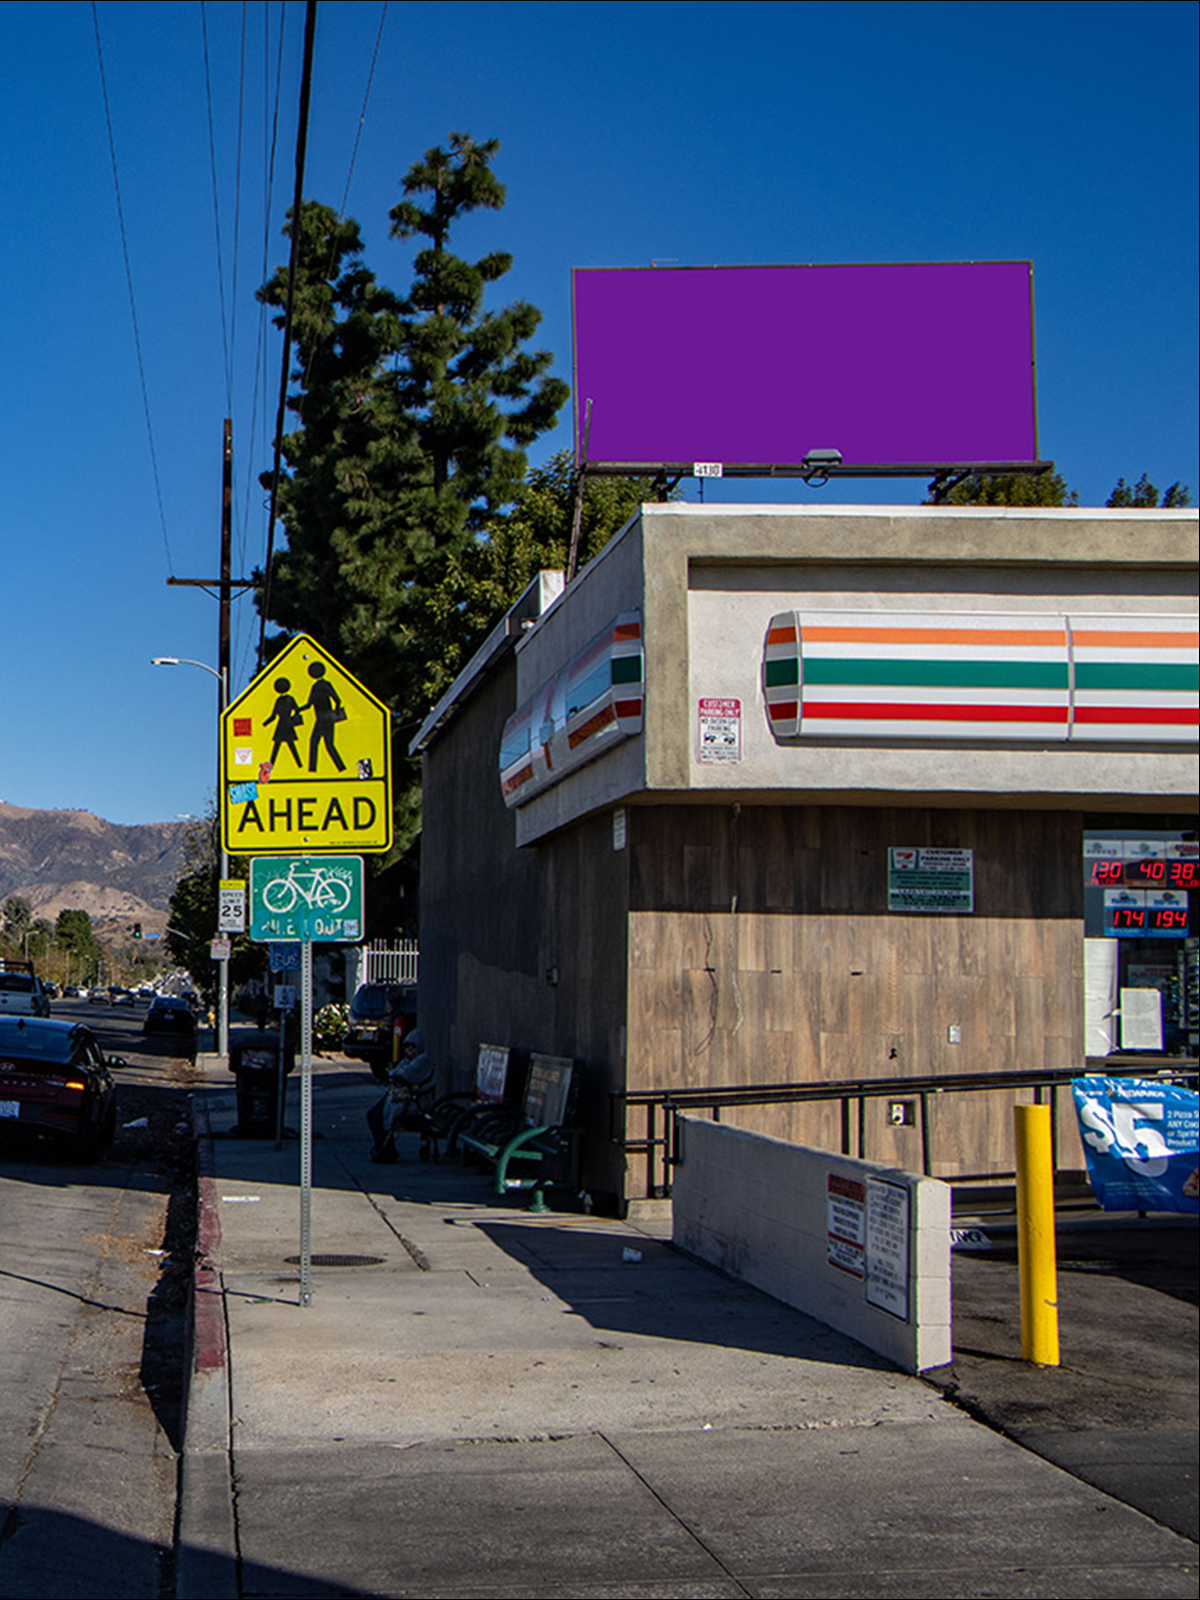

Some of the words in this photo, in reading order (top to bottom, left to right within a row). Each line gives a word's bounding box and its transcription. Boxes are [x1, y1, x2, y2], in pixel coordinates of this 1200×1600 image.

[237, 796, 377, 833] AHEAD
[1091, 861, 1122, 879] 130
[1140, 862, 1164, 880] 40
[1170, 863, 1199, 880] 38
[222, 905, 243, 918] 25
[1114, 910, 1145, 927] 174
[1156, 910, 1187, 928] 194
[1167, 1110, 1173, 1119] 2
[1174, 1110, 1193, 1119] Pizza
[1167, 1120, 1183, 1128] ANY
[1079, 1097, 1169, 1179] $5
[1167, 1138, 1197, 1147] Product
